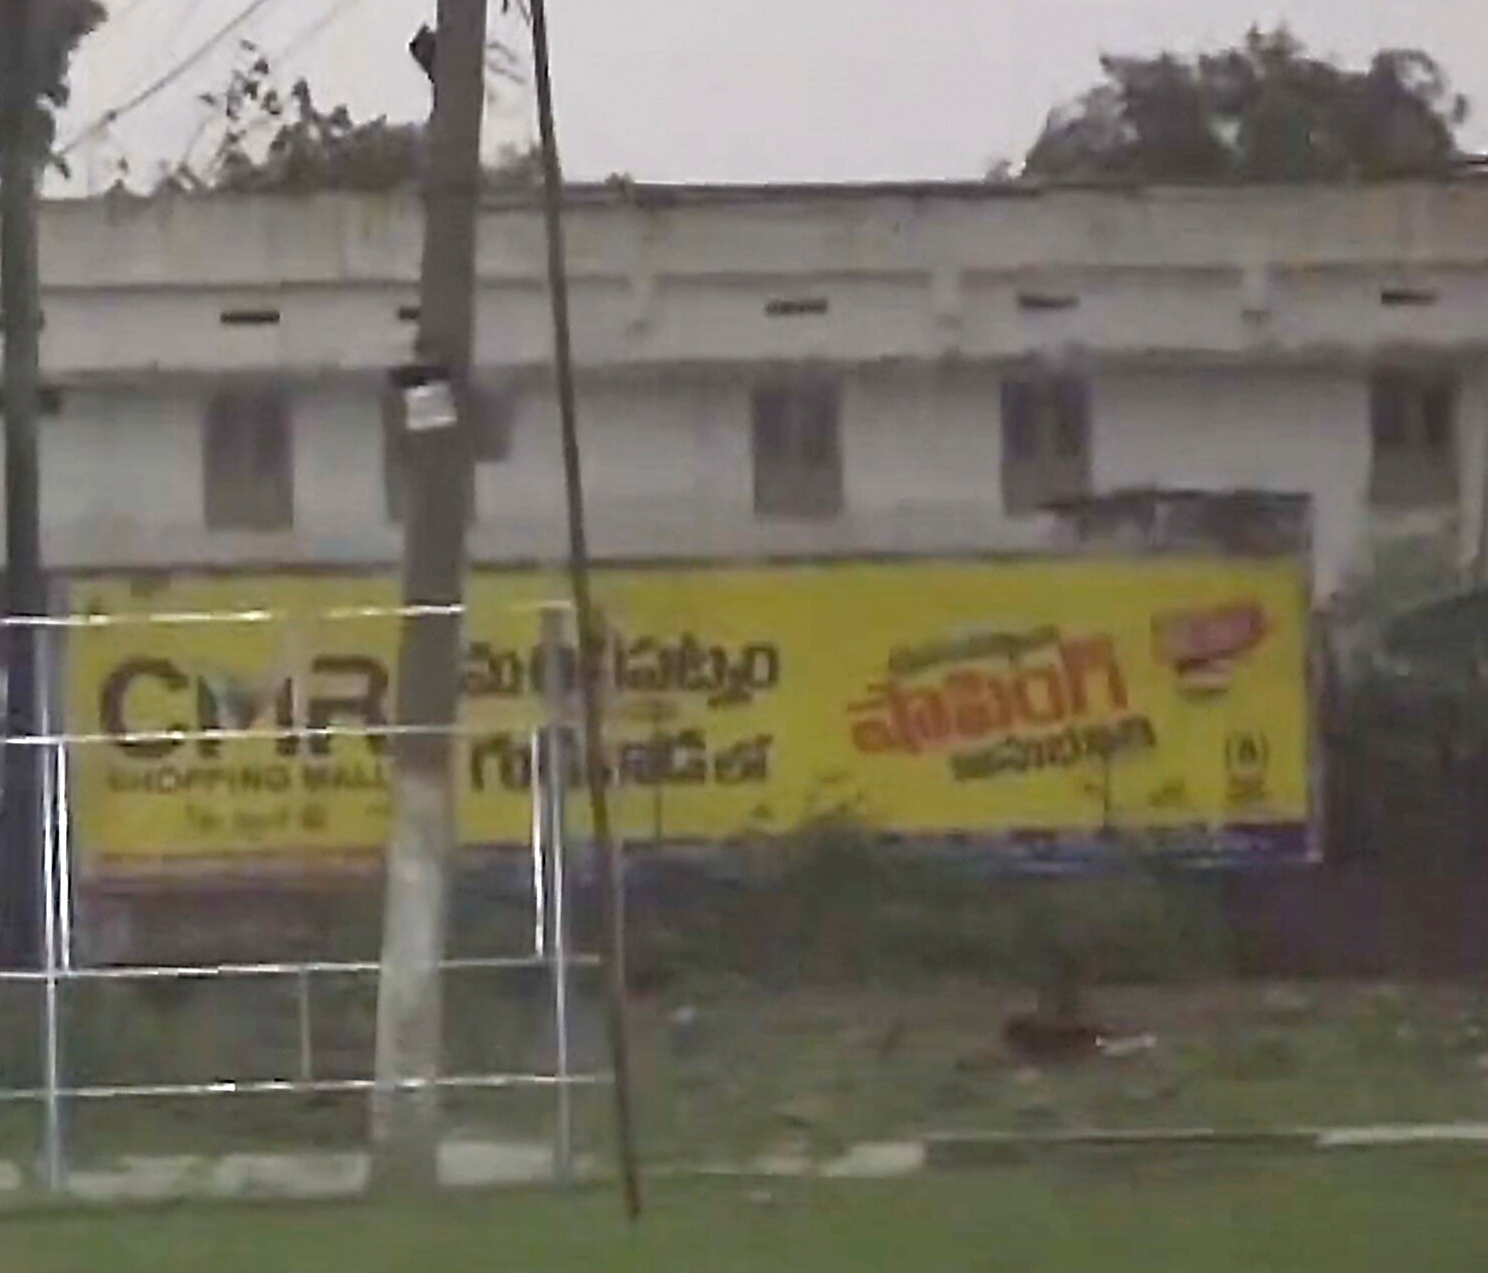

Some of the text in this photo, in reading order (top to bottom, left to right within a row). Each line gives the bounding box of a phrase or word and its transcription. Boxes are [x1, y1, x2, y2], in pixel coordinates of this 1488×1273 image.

[98, 655, 391, 759] CMR
[107, 762, 390, 794] SHOPPING MALL
